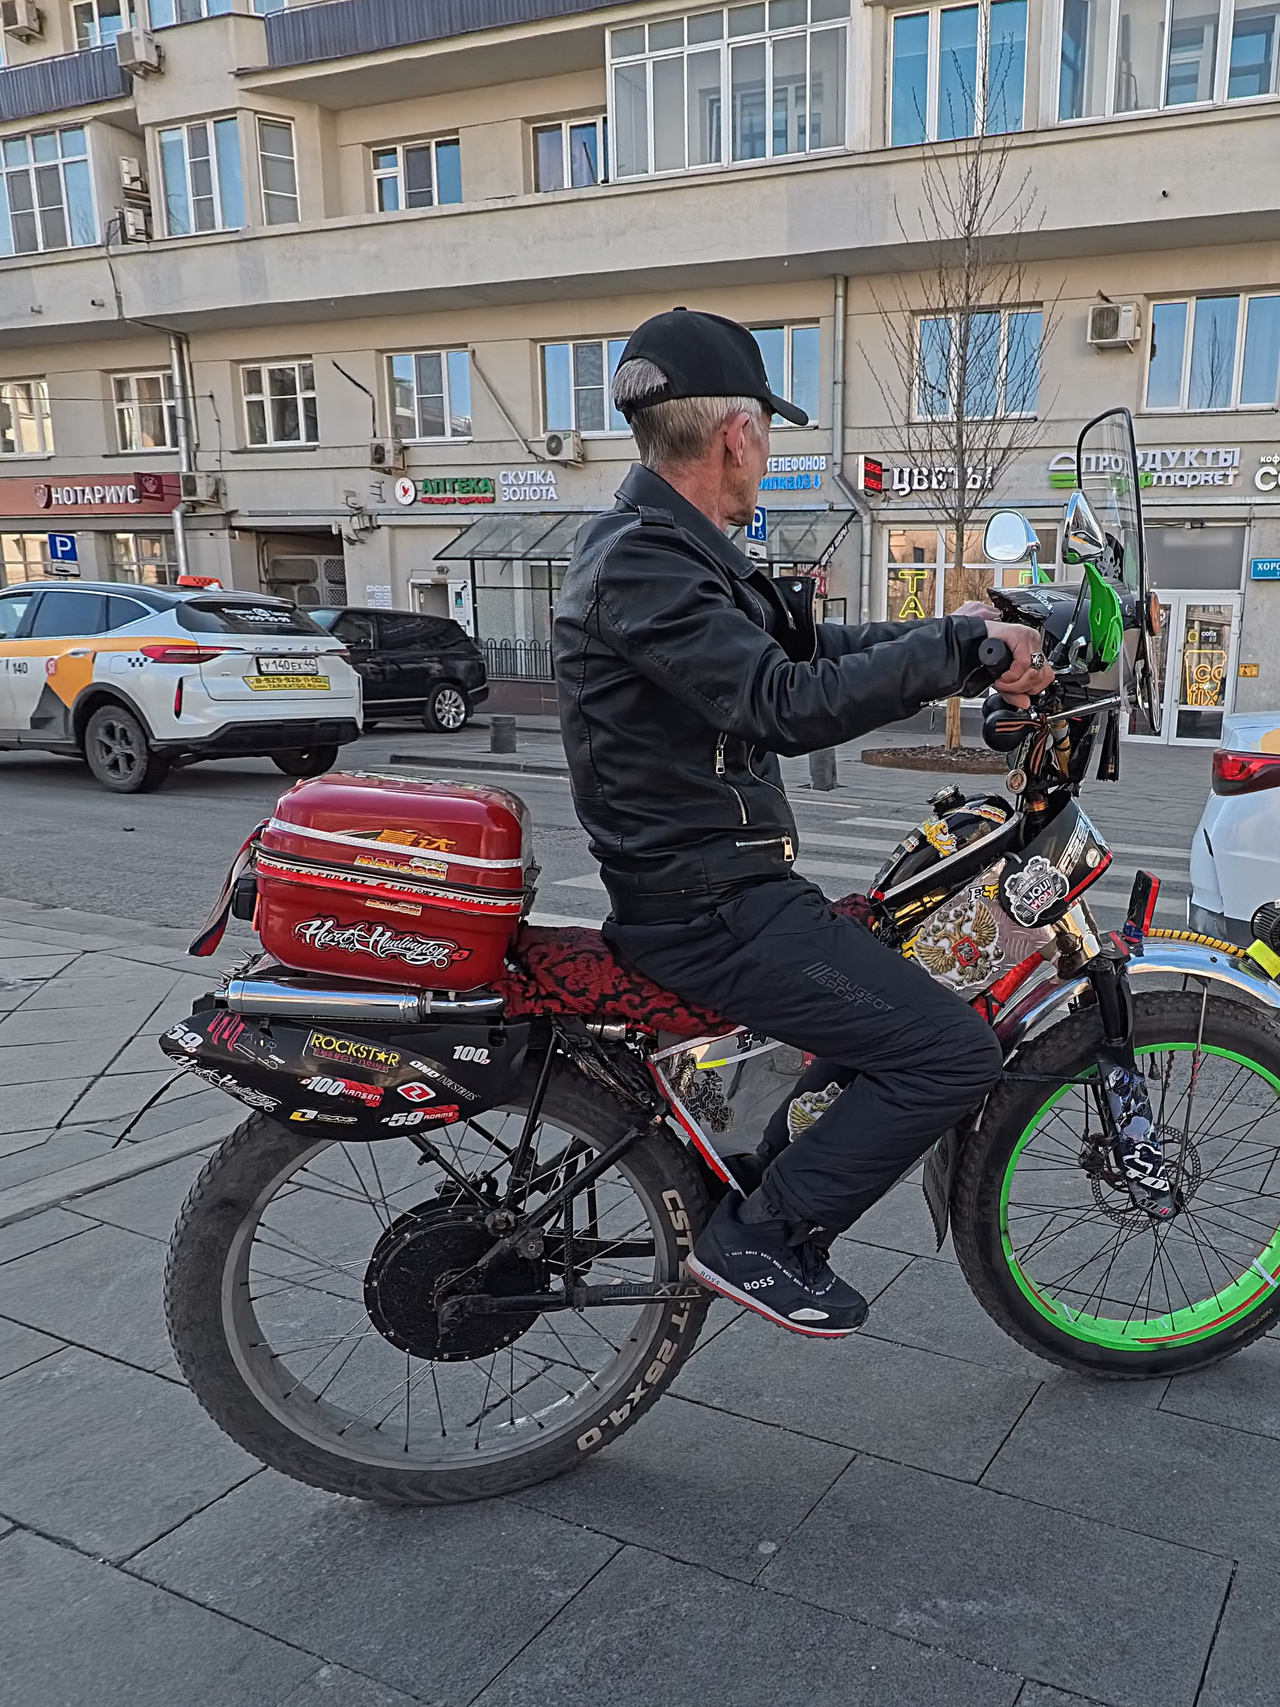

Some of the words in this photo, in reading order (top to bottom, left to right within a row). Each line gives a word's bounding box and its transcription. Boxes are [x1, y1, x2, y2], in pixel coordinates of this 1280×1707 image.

[421, 478, 493, 495] АПТЕКА
[500, 470, 557, 486] СКУПКА
[51, 484, 140, 505] НОТАРИУС
[502, 486, 558, 500] ЗОЛОТА
[355, 855, 447, 880] MALOSSI
[1023, 879, 1051, 904] LIQUI
[1030, 889, 1053, 910] MOLY
[816, 977, 866, 1007] SPORT
[826, 970, 895, 1013] PEUGEOT
[166, 1023, 203, 1048] 59
[313, 1048, 355, 1064] ENERGY
[359, 1056, 389, 1072] DRINK
[453, 1046, 489, 1063] 100
[306, 1076, 345, 1096] 100
[342, 1087, 382, 1102] HANSEN
[438, 1075, 477, 1101] INDUSTRIES
[388, 1111, 424, 1127] 59
[424, 1111, 454, 1121] ADAMS
[662, 1189, 694, 1252] CST
[743, 1276, 775, 1291] BOSS
